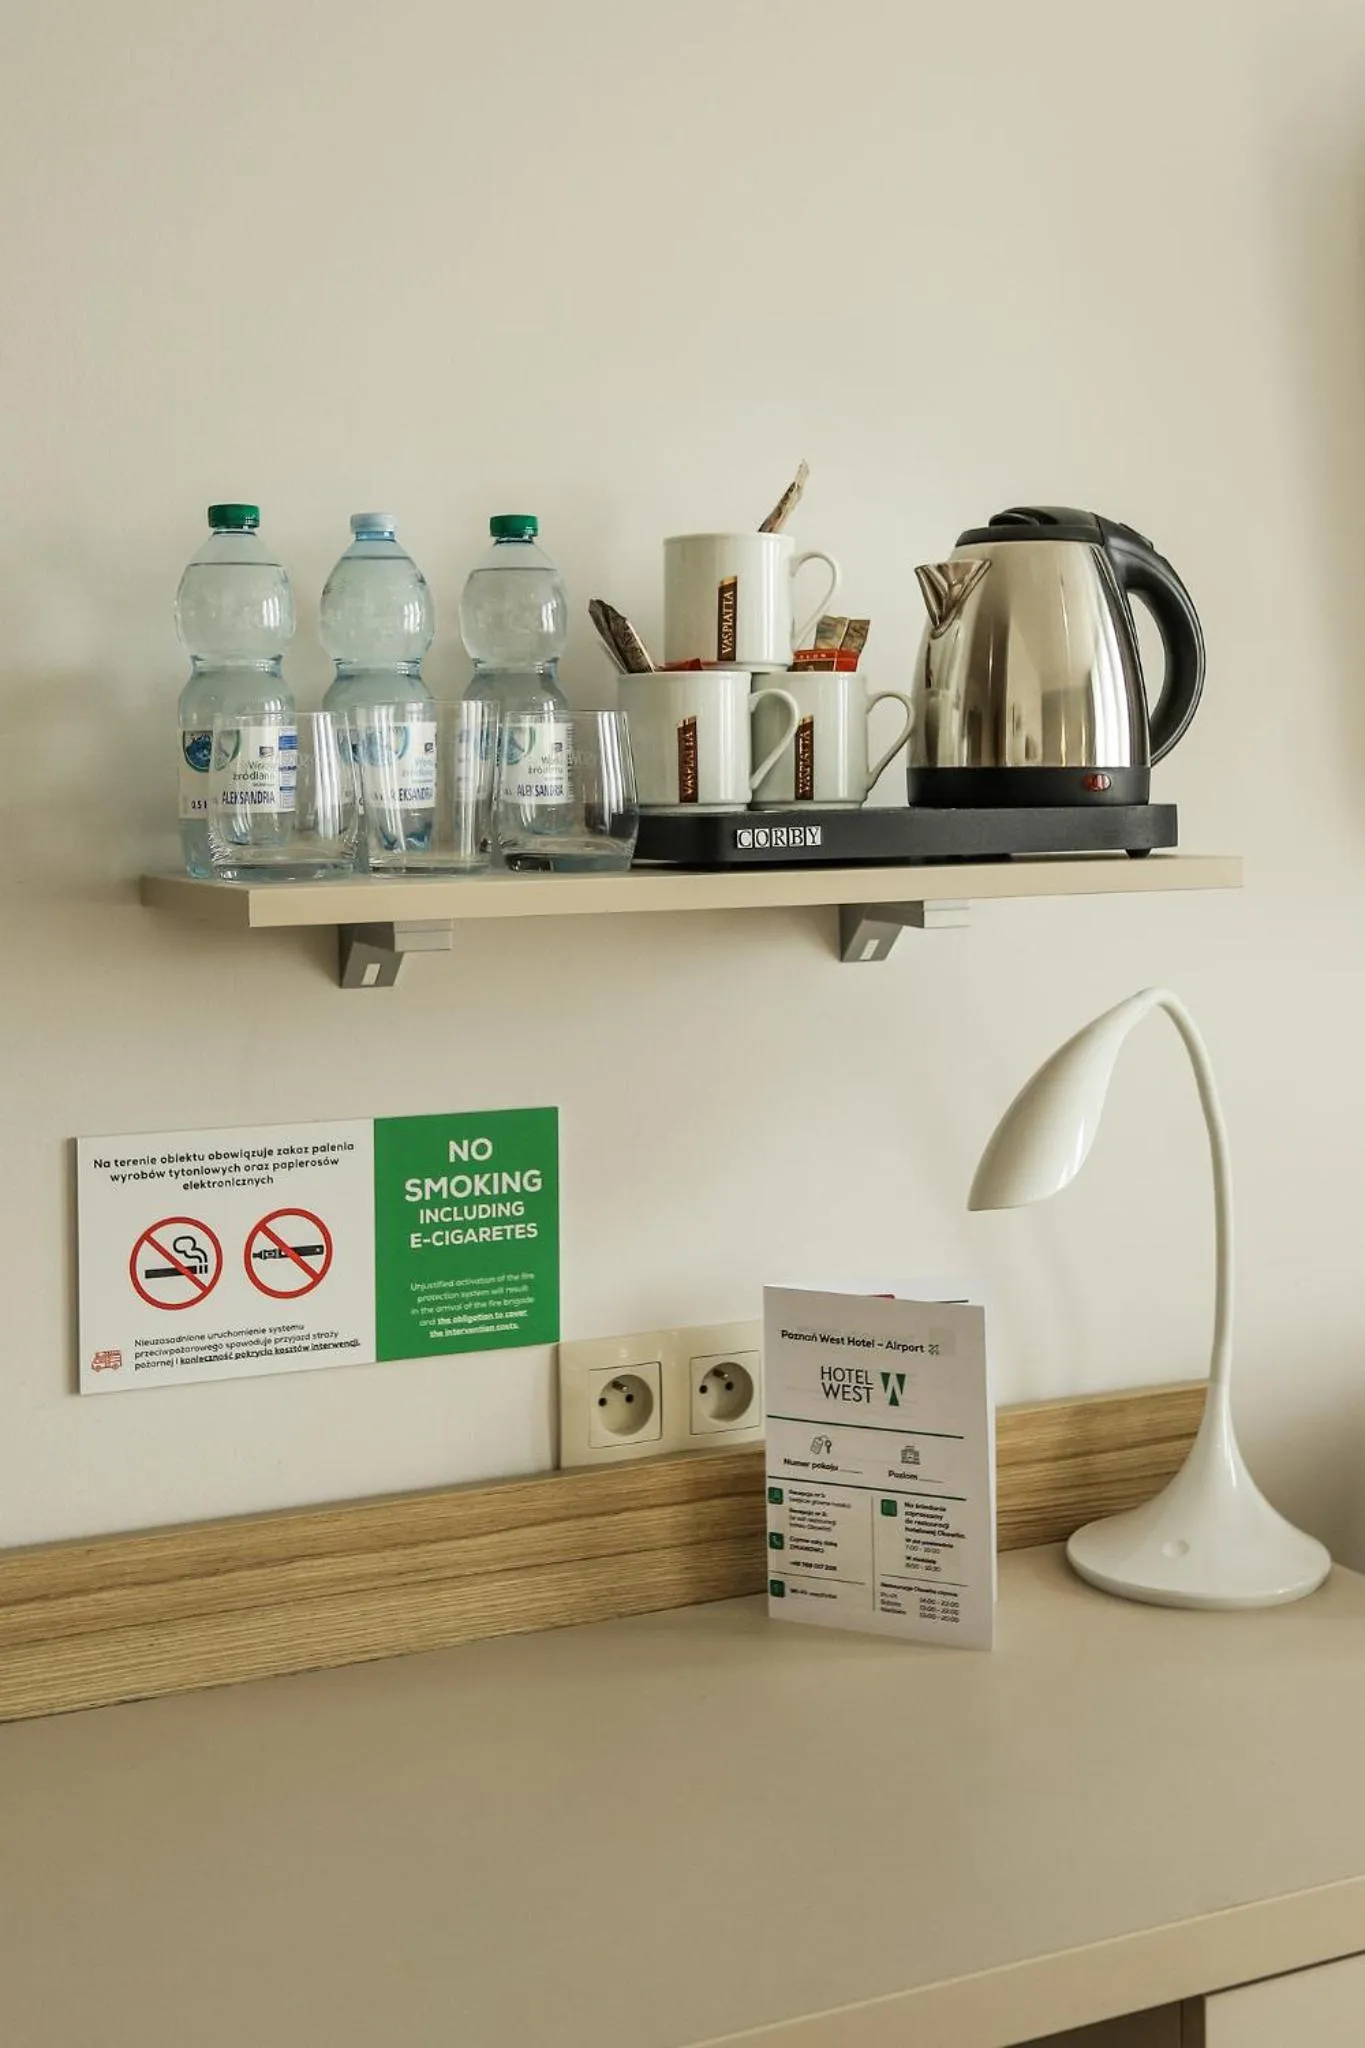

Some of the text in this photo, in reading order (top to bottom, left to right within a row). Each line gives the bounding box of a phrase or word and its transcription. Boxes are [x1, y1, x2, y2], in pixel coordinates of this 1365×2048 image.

[722, 590, 735, 654] VASPIATTA
[738, 826, 821, 849] CORBY
[93, 1141, 355, 1169] Na terenie obiektu obowiązuje zakaz palenia
[448, 1137, 494, 1163] NO
[109, 1156, 340, 1184] wyrobów tytoniowych oraz papierosów
[182, 1174, 275, 1191] elektronicznych
[404, 1169, 543, 1202] SMOKING
[419, 1201, 526, 1225] INCLUDING
[409, 1222, 539, 1249] E-CIGARETES
[410, 1271, 535, 1292] Unjustified activation of the fire
[417, 1284, 529, 1304] protection system will result
[411, 1296, 535, 1315] in the arrival of the fire brigade
[418, 1318, 436, 1327] and
[437, 1316, 452, 1326] the
[452, 1311, 494, 1324] obligation
[494, 1311, 504, 1320] to
[134, 1323, 305, 1348] Nieuzasadnione uruchomienie systemu
[225, 1336, 272, 1351] spowoduje
[273, 1332, 311, 1345] przyjazd
[311, 1330, 340, 1341] straży
[429, 1329, 444, 1339] the
[444, 1324, 495, 1337] intervention
[780, 1329, 818, 1344] Poznań
[818, 1333, 846, 1346] West
[847, 1337, 875, 1349] Hotel
[885, 1339, 925, 1354] Airport
[134, 1357, 174, 1372] pożarnej
[180, 1351, 234, 1366] konieczność
[234, 1348, 273, 1361] pokrycia
[274, 1345, 310, 1356] kosztów
[820, 1365, 874, 1386] HOTEL
[821, 1382, 875, 1404] WEST
[783, 1457, 839, 1473] Numer pokoju
[887, 1469, 919, 1482] Poziom
